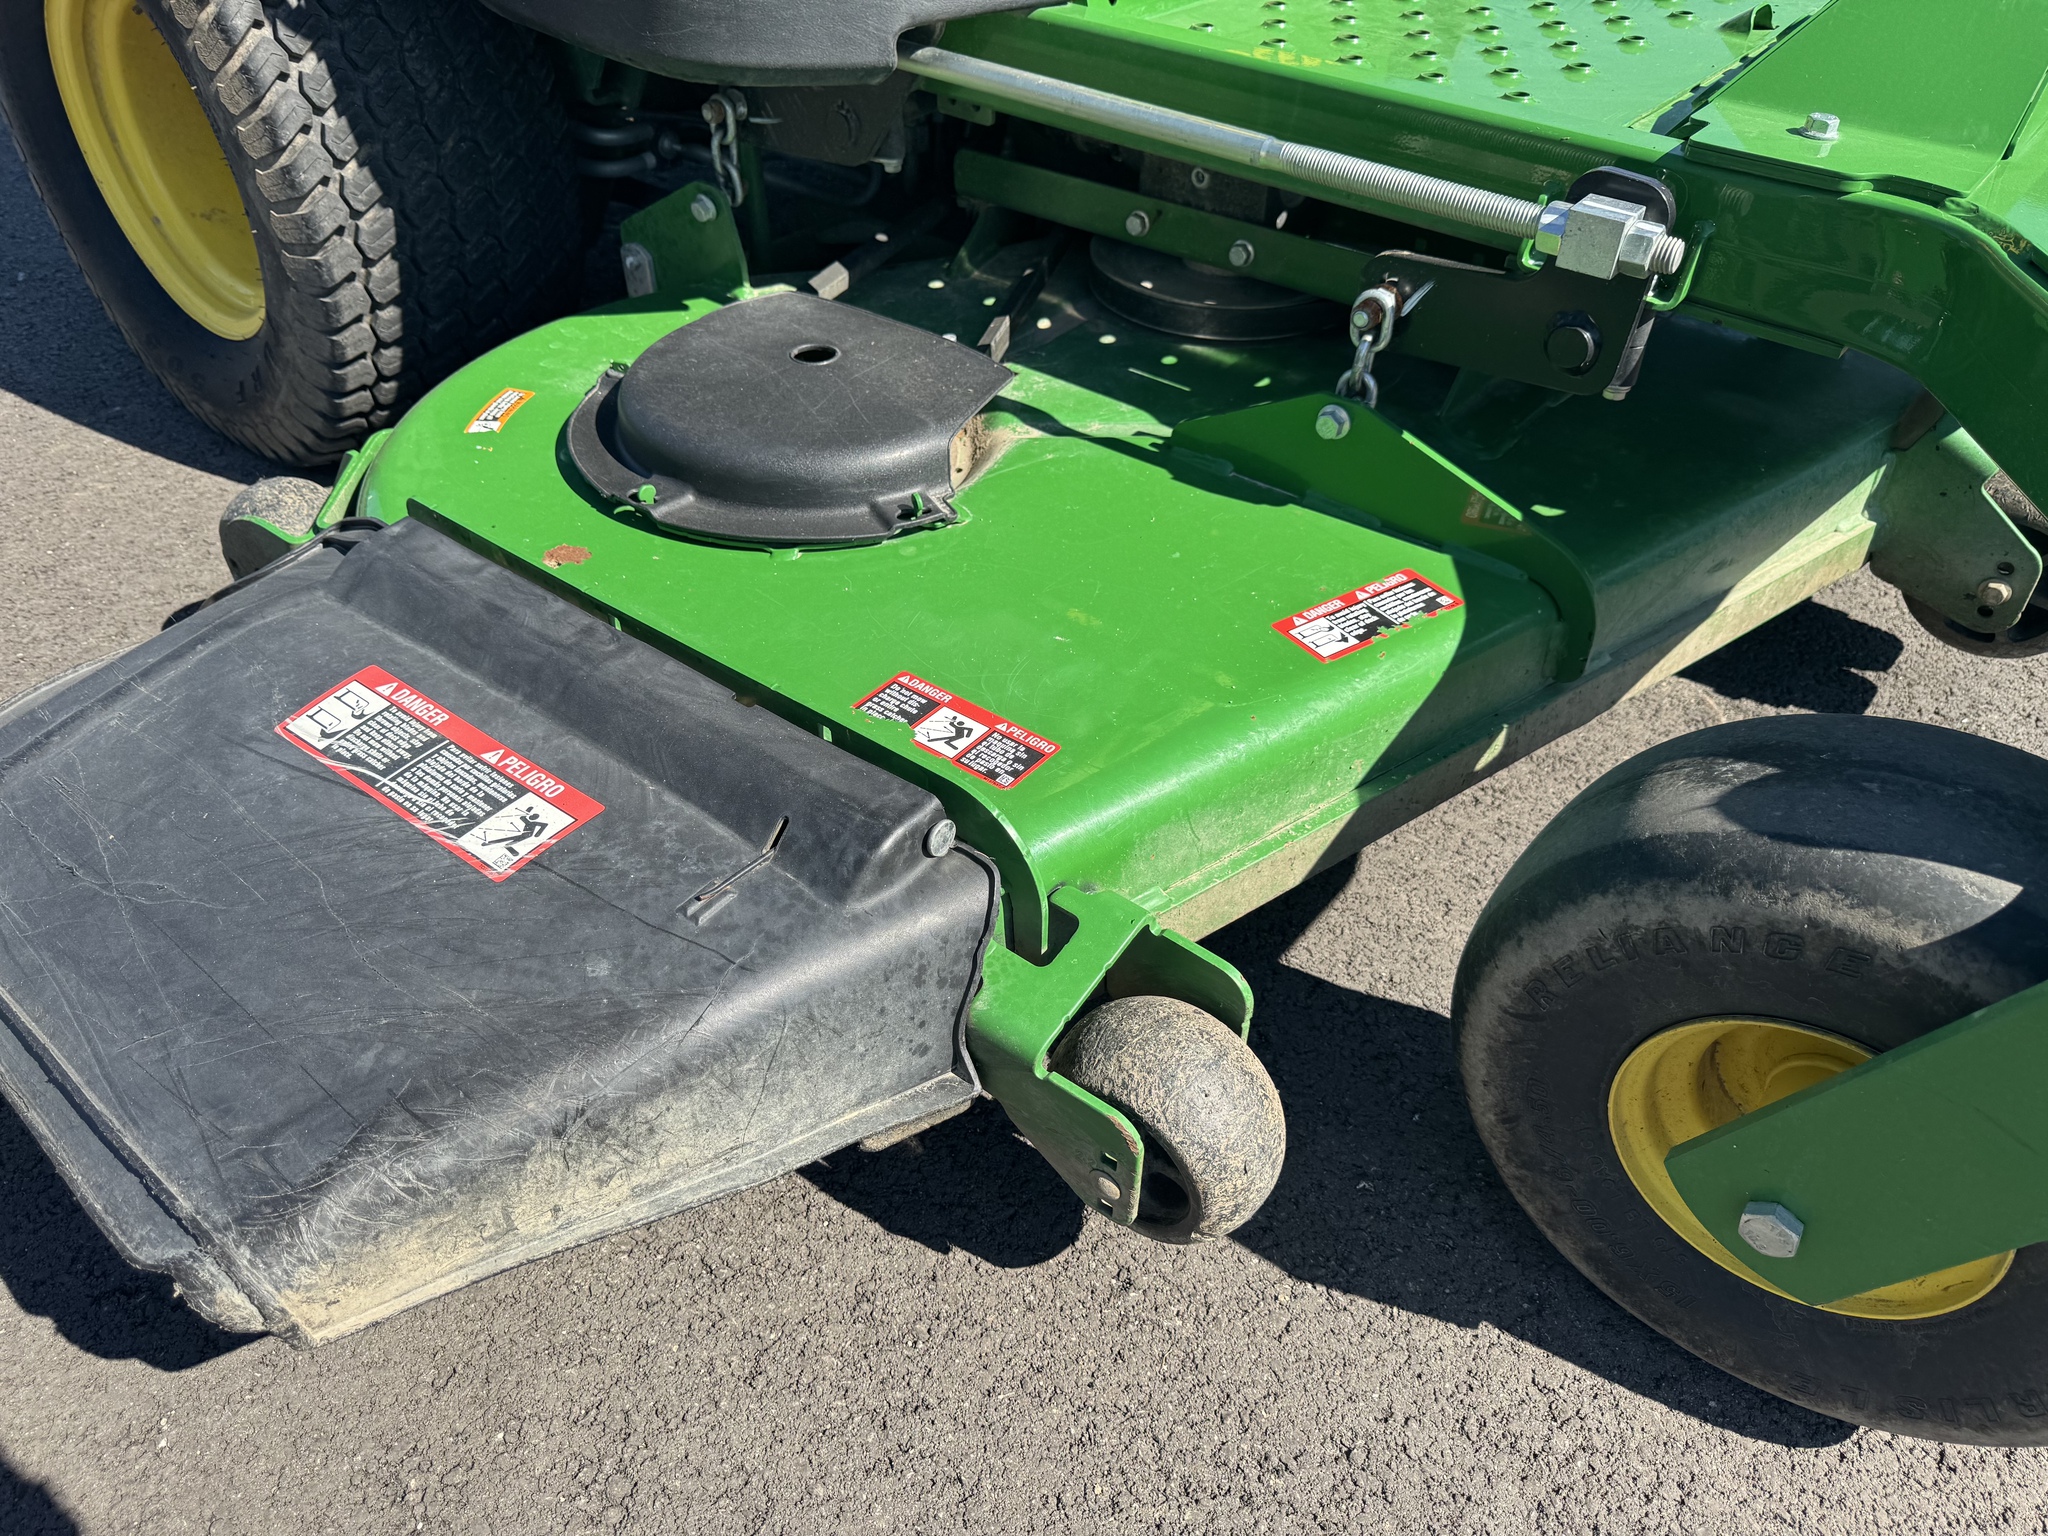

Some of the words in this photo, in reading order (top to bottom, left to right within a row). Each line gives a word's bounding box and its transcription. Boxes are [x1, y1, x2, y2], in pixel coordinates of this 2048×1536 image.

[1301, 599, 1346, 620] DANGER
[883, 687, 910, 702] without
[890, 683, 903, 691] Do
[898, 687, 913, 696] not
[909, 694, 928, 704] mow
[907, 678, 953, 703] DANGER
[389, 687, 450, 726] DANGER
[863, 701, 885, 713] grass
[875, 691, 902, 706] charge
[898, 702, 919, 714] chute
[878, 700, 900, 712] entire
[990, 732, 1004, 740] No
[1000, 737, 1019, 747] usar
[1005, 725, 1056, 753] PELIGRO
[974, 744, 1008, 762] descarga
[1011, 761, 1025, 770] sin
[988, 743, 1006, 754] tubo
[1003, 751, 1016, 759] de
[1014, 750, 1028, 759] sin
[966, 760, 990, 774] lugar.
[973, 757, 996, 770] pasto
[496, 754, 566, 799] PELIGRO
[1524, 925, 1873, 1012] RELIANCE
[1789, 1371, 2048, 1424] RLISLE
